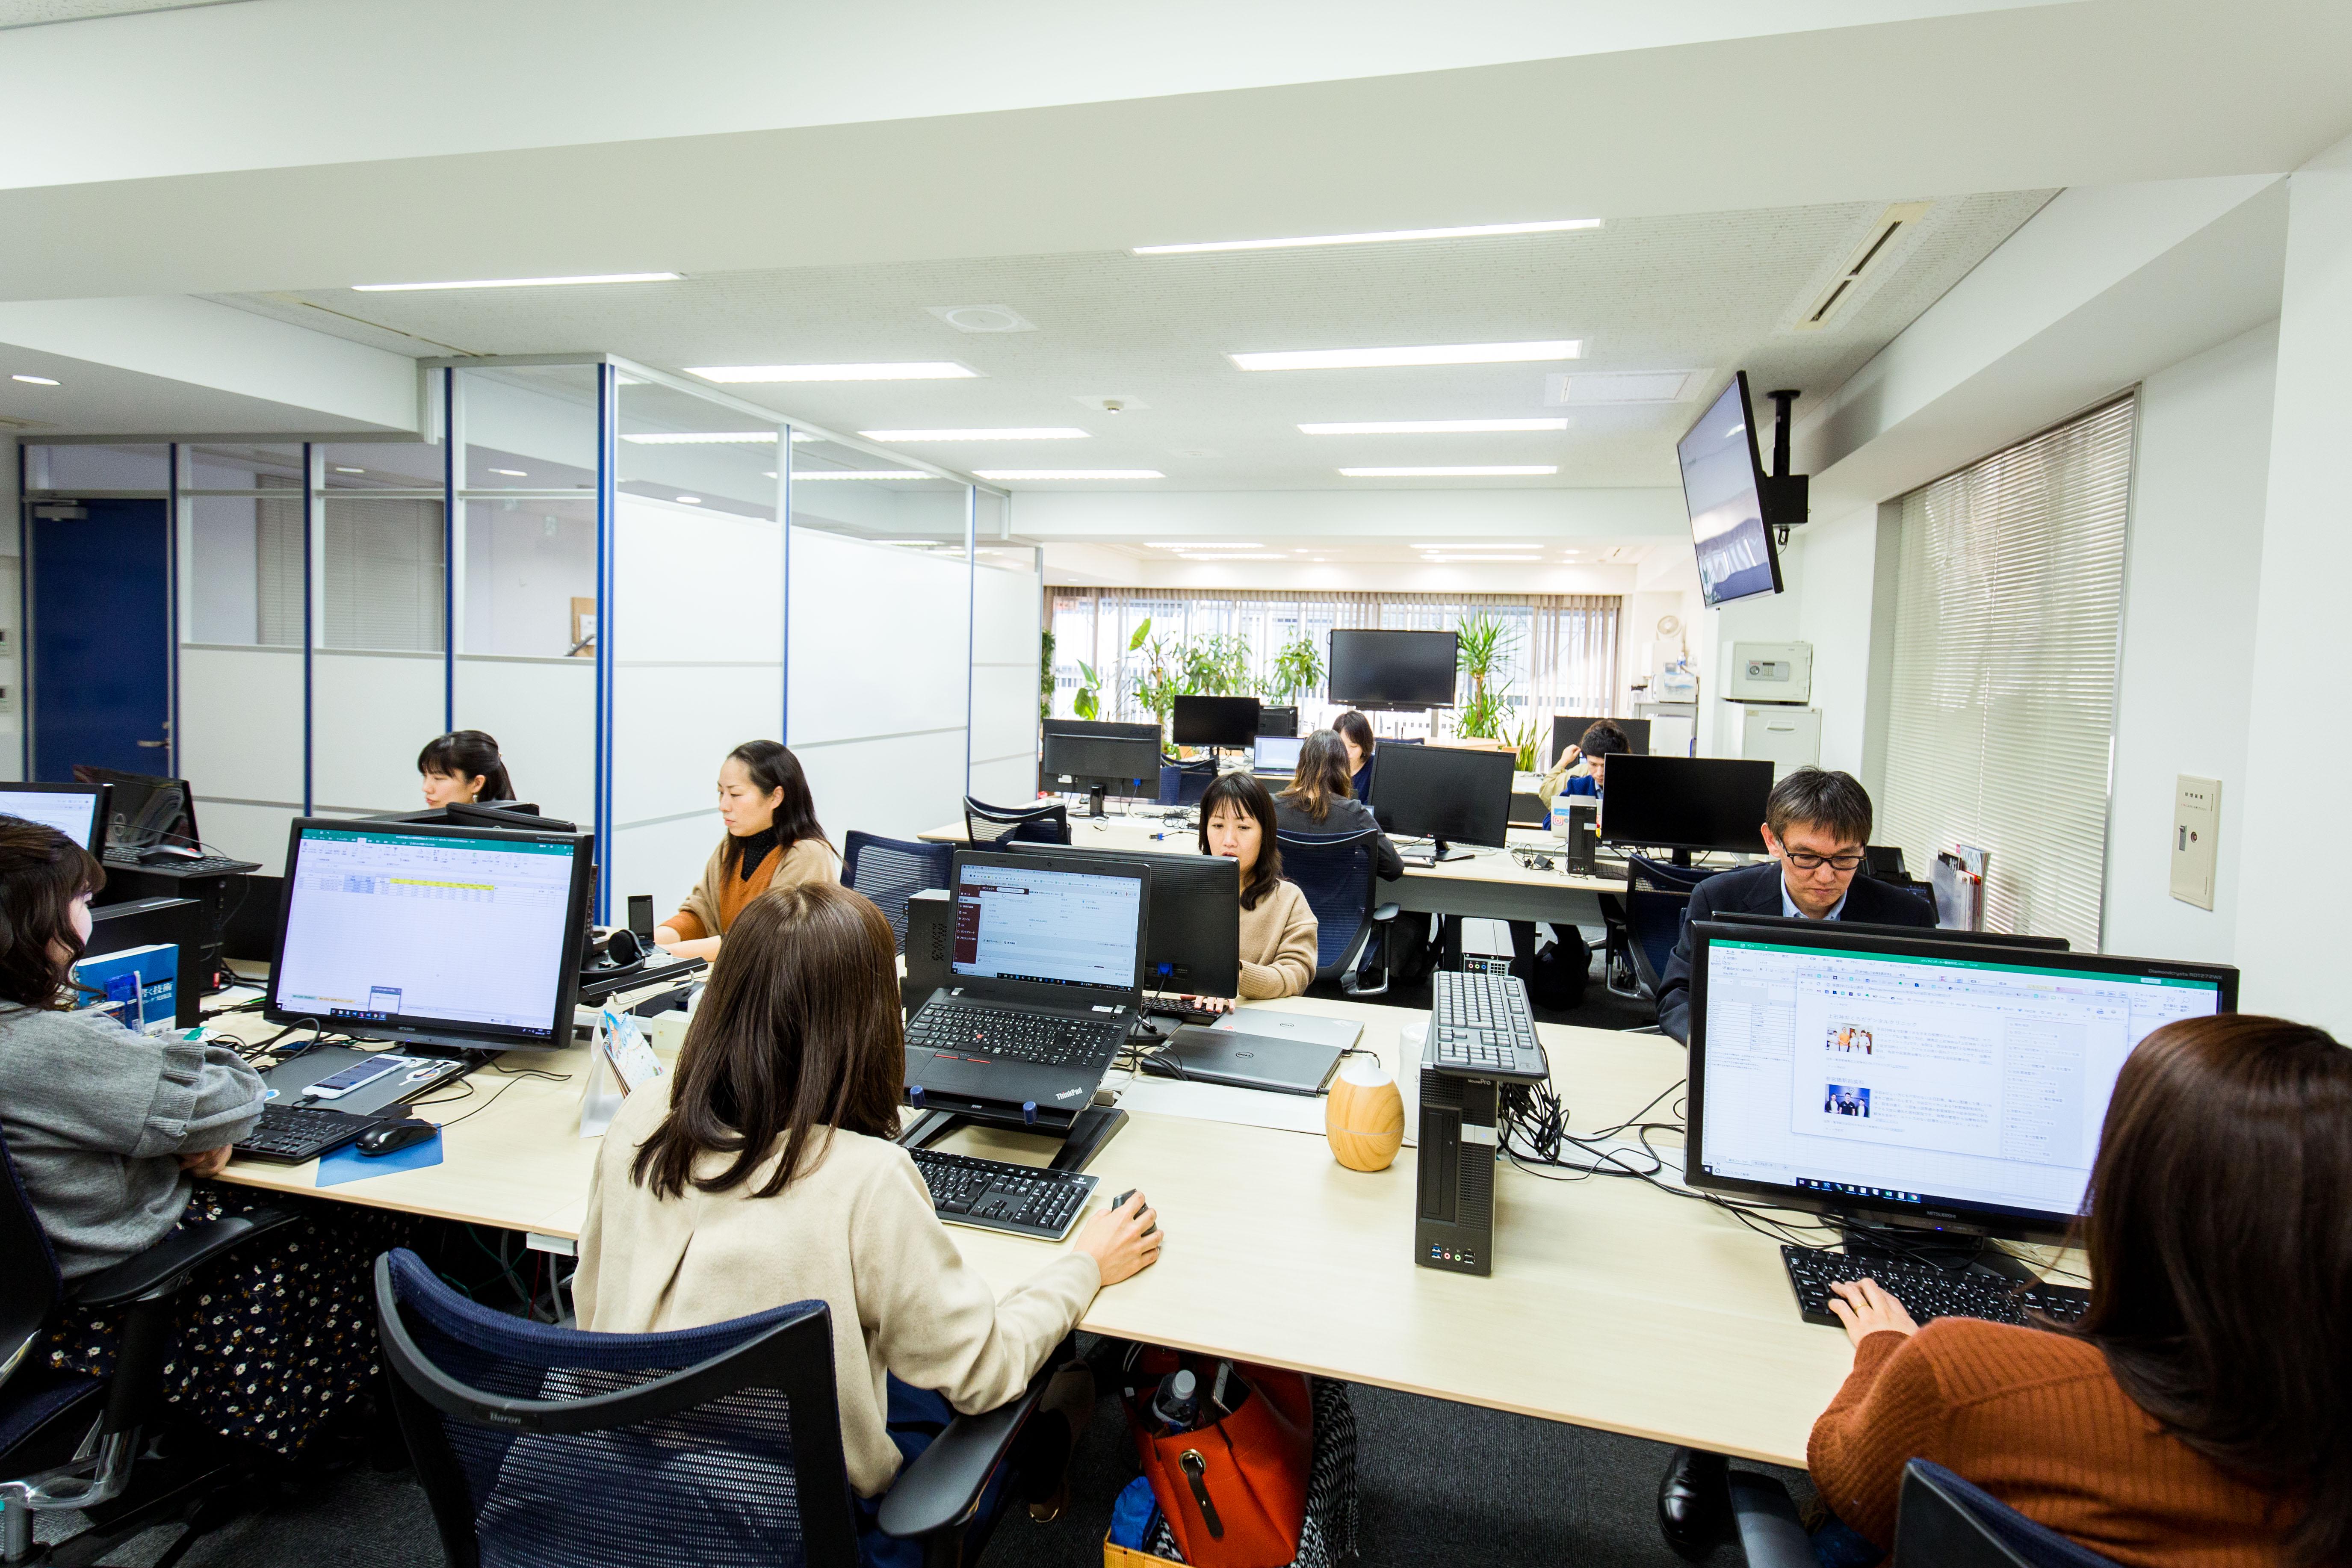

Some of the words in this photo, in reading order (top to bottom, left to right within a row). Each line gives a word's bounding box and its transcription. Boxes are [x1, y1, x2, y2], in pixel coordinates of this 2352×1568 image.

[2148, 969, 2188, 977] Diamondcrysta
[1828, 1014, 1917, 1027] 上石神井くろだデンタルクリニック
[1826, 1076, 1864, 1085] 参宮橋駅前歯科
[1055, 1087, 1083, 1100] ThinkPad
[490, 1411, 521, 1425] Baron
